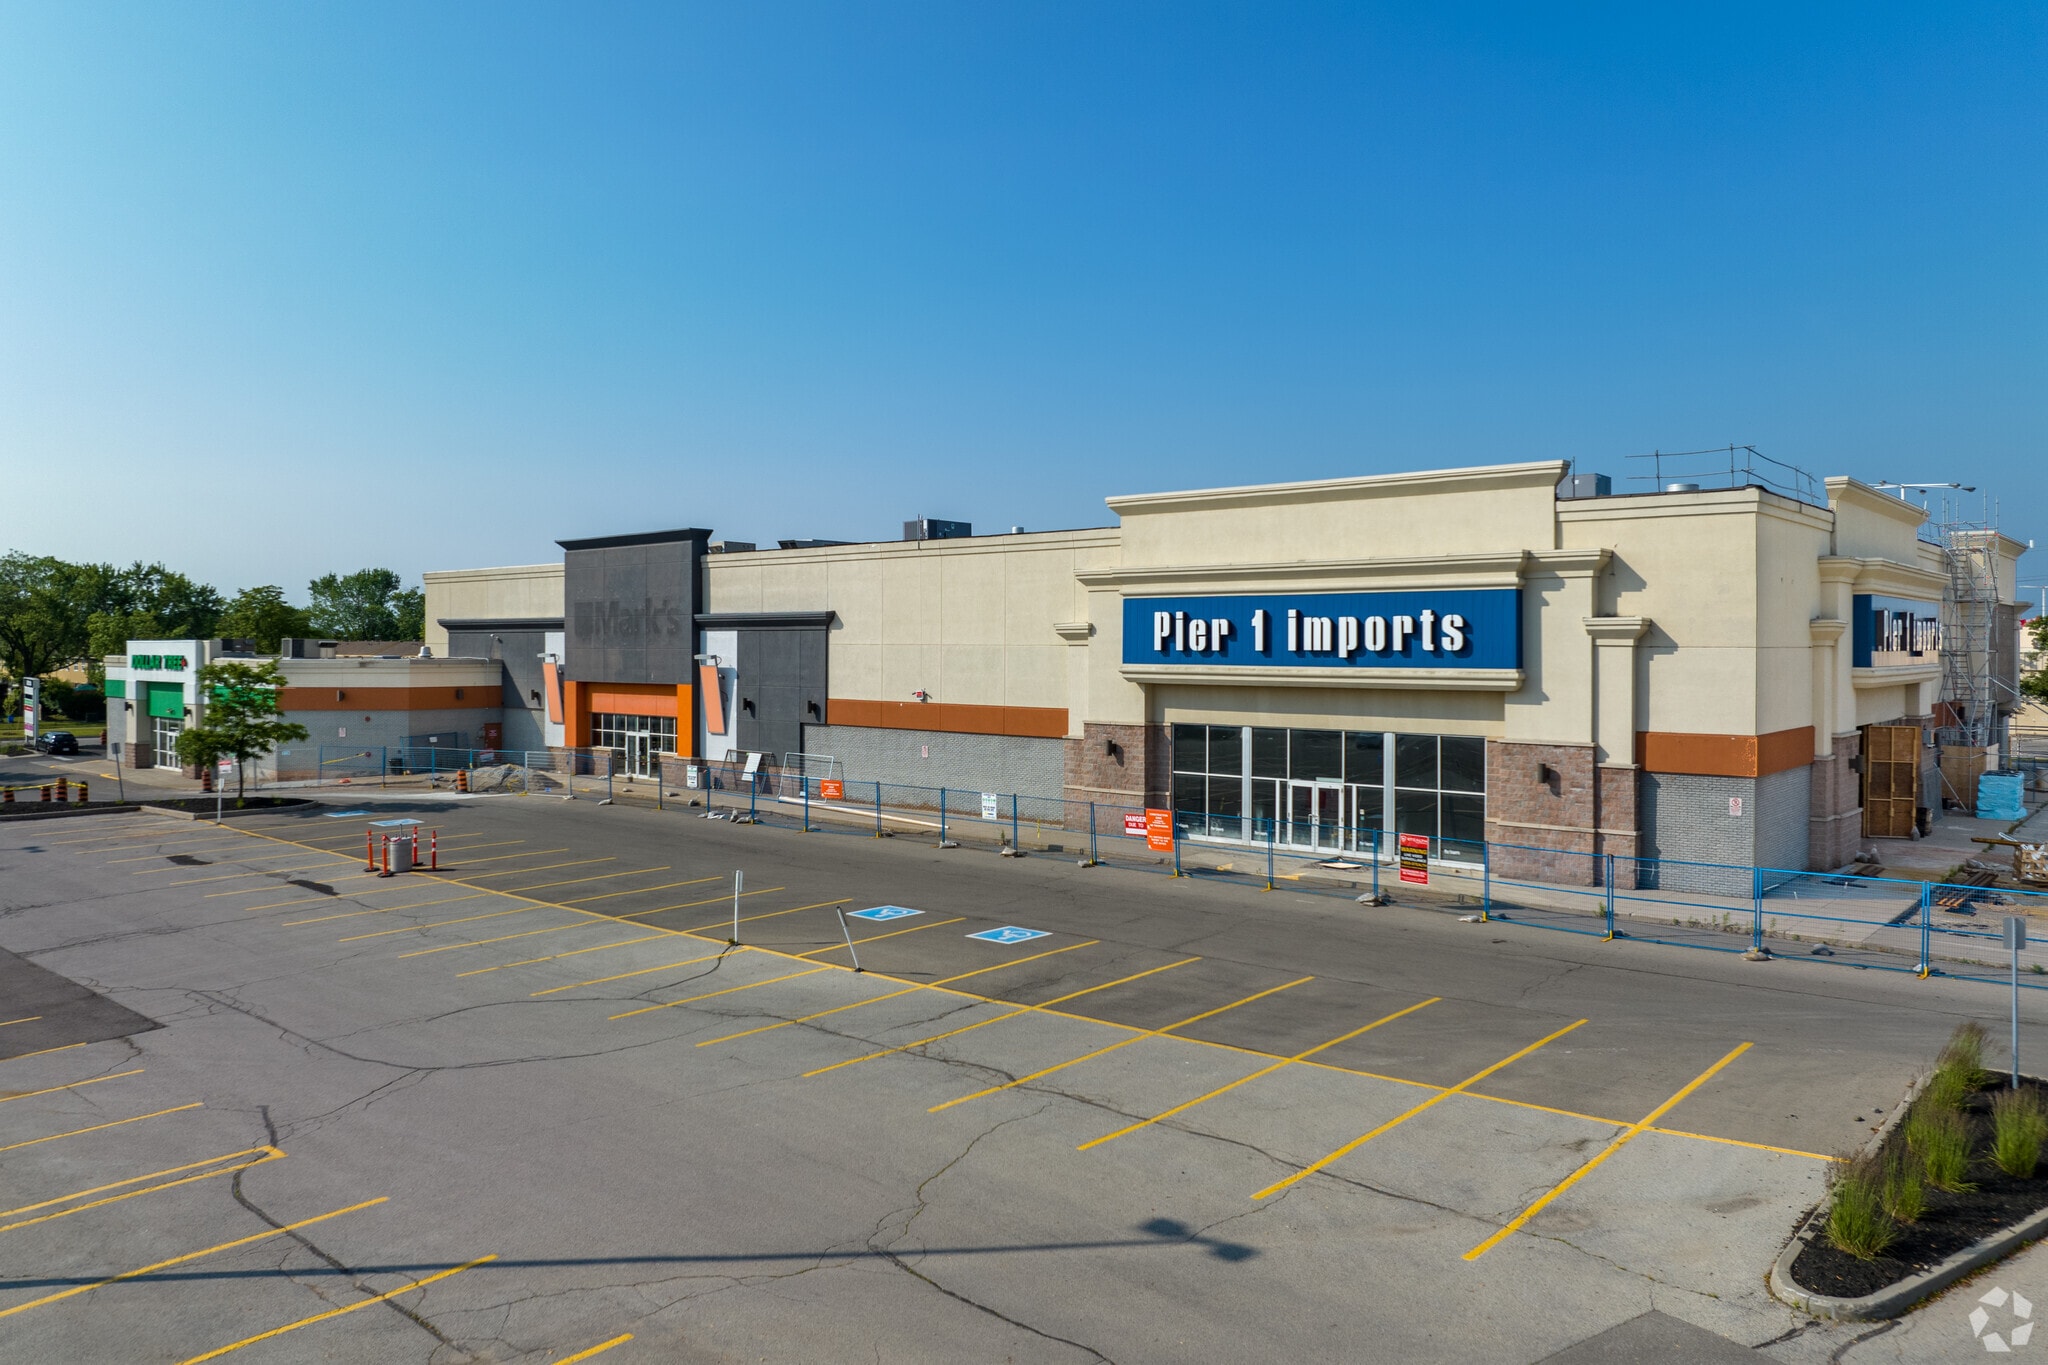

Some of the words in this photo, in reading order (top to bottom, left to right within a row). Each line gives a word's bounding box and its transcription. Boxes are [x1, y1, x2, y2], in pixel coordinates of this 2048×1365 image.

[1154, 610, 1229, 652] Pier
[1251, 609, 1266, 652] 1
[1287, 608, 1465, 659] imports
[131, 654, 162, 670] DOLLAR
[163, 654, 184, 671] TREE
[1125, 814, 1147, 823] DANGER
